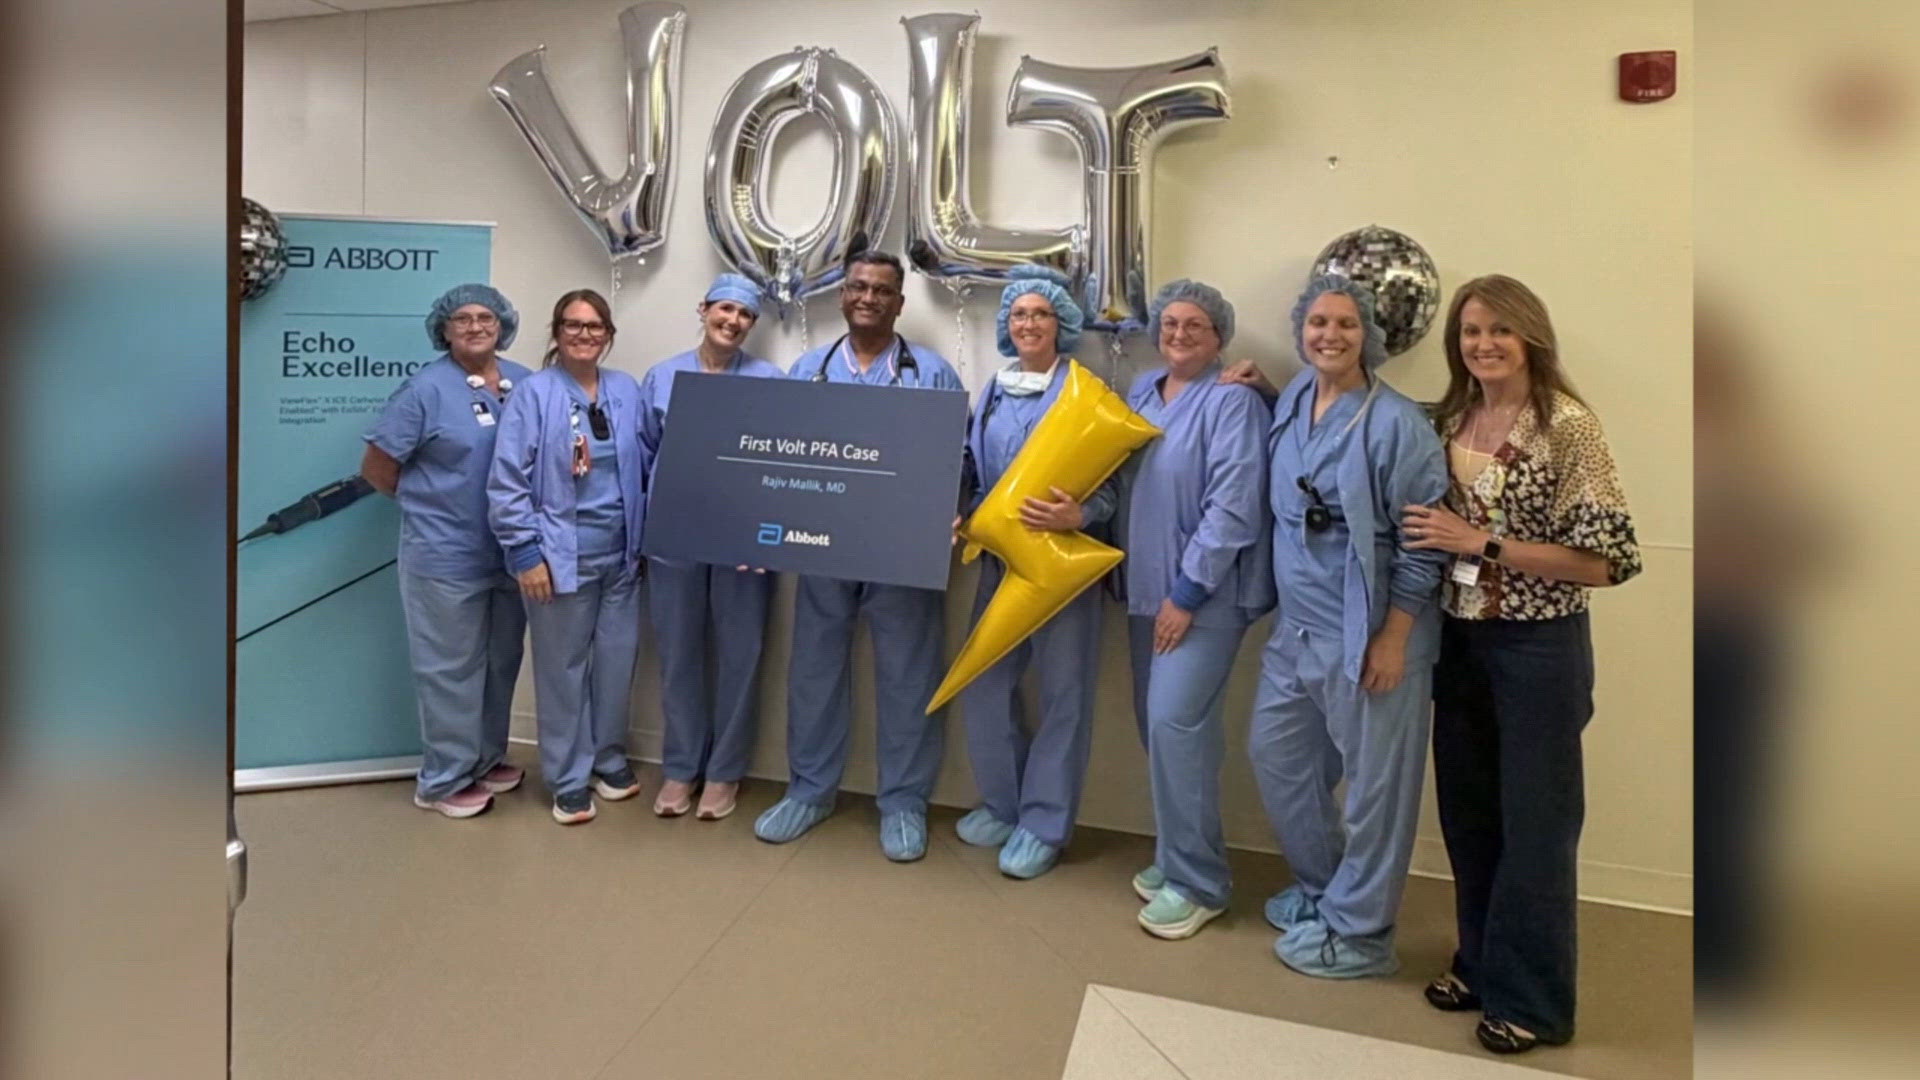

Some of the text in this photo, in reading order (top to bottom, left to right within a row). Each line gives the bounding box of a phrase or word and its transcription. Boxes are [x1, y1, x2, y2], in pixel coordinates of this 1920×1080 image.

[488, 2, 1232, 332] VOLT
[324, 246, 439, 271] ABBOTT
[282, 331, 356, 354] Echo
[279, 417, 326, 425] Integration
[739, 434, 880, 461] First Volt PFA Case
[762, 475, 846, 494] Rajiv Mallik, MD
[784, 530, 830, 547] Abbott
